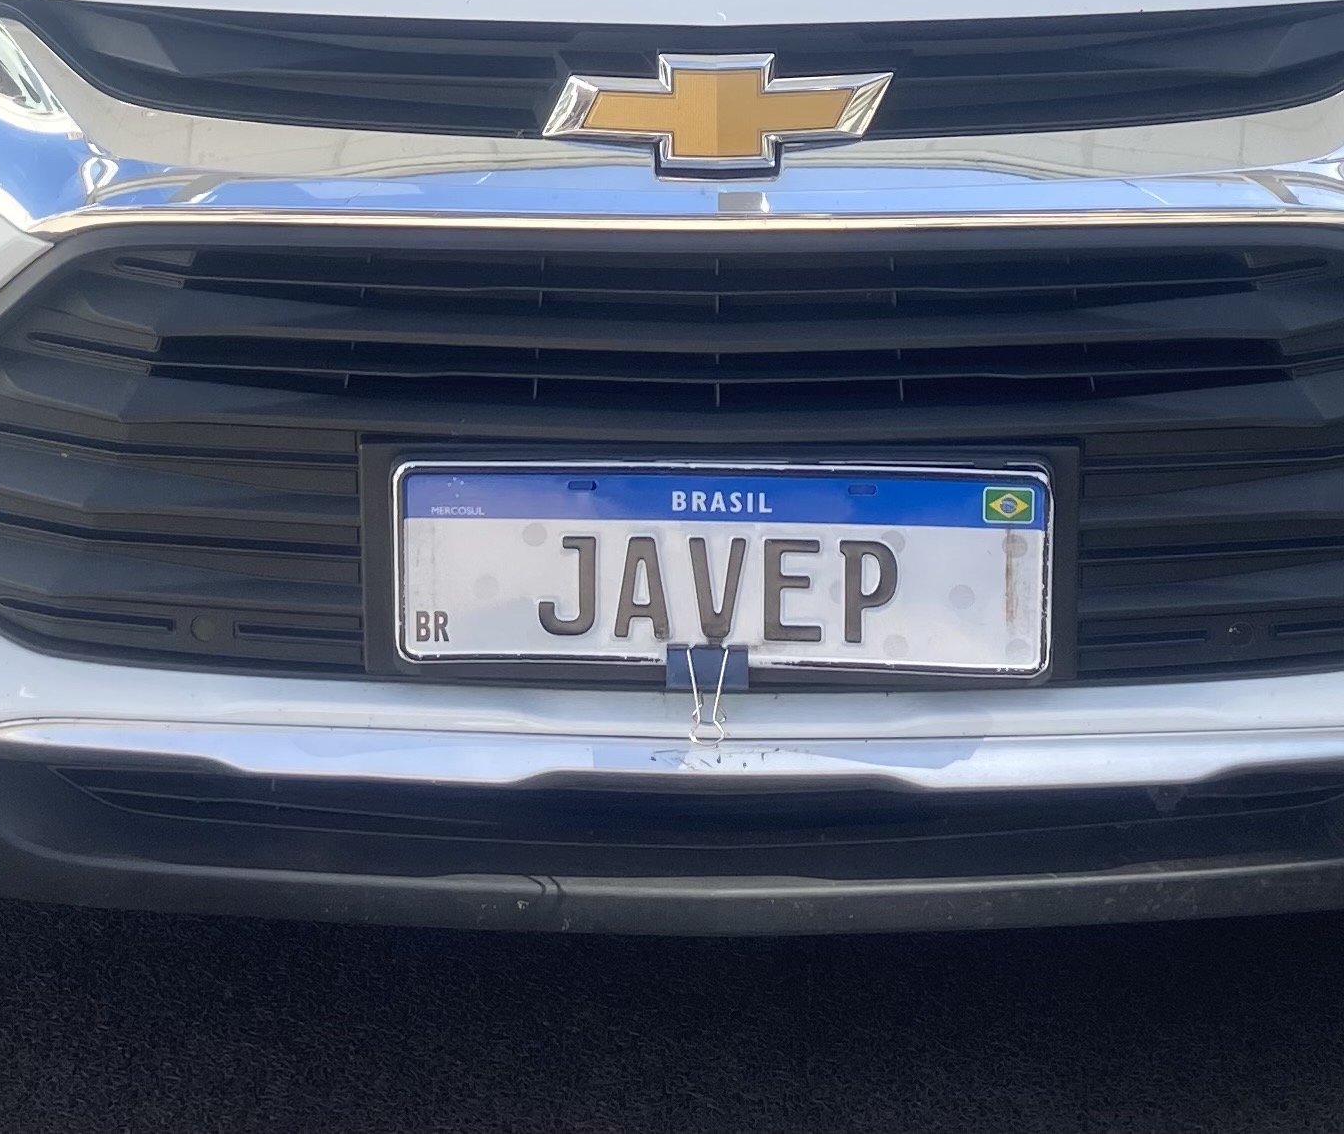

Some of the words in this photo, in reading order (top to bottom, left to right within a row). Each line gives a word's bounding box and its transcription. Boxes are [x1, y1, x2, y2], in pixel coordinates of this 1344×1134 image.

[431, 506, 485, 516] MERCOSUL
[671, 490, 773, 514] BRASIL
[538, 536, 898, 644] JAVEP
[416, 610, 449, 642] BR
